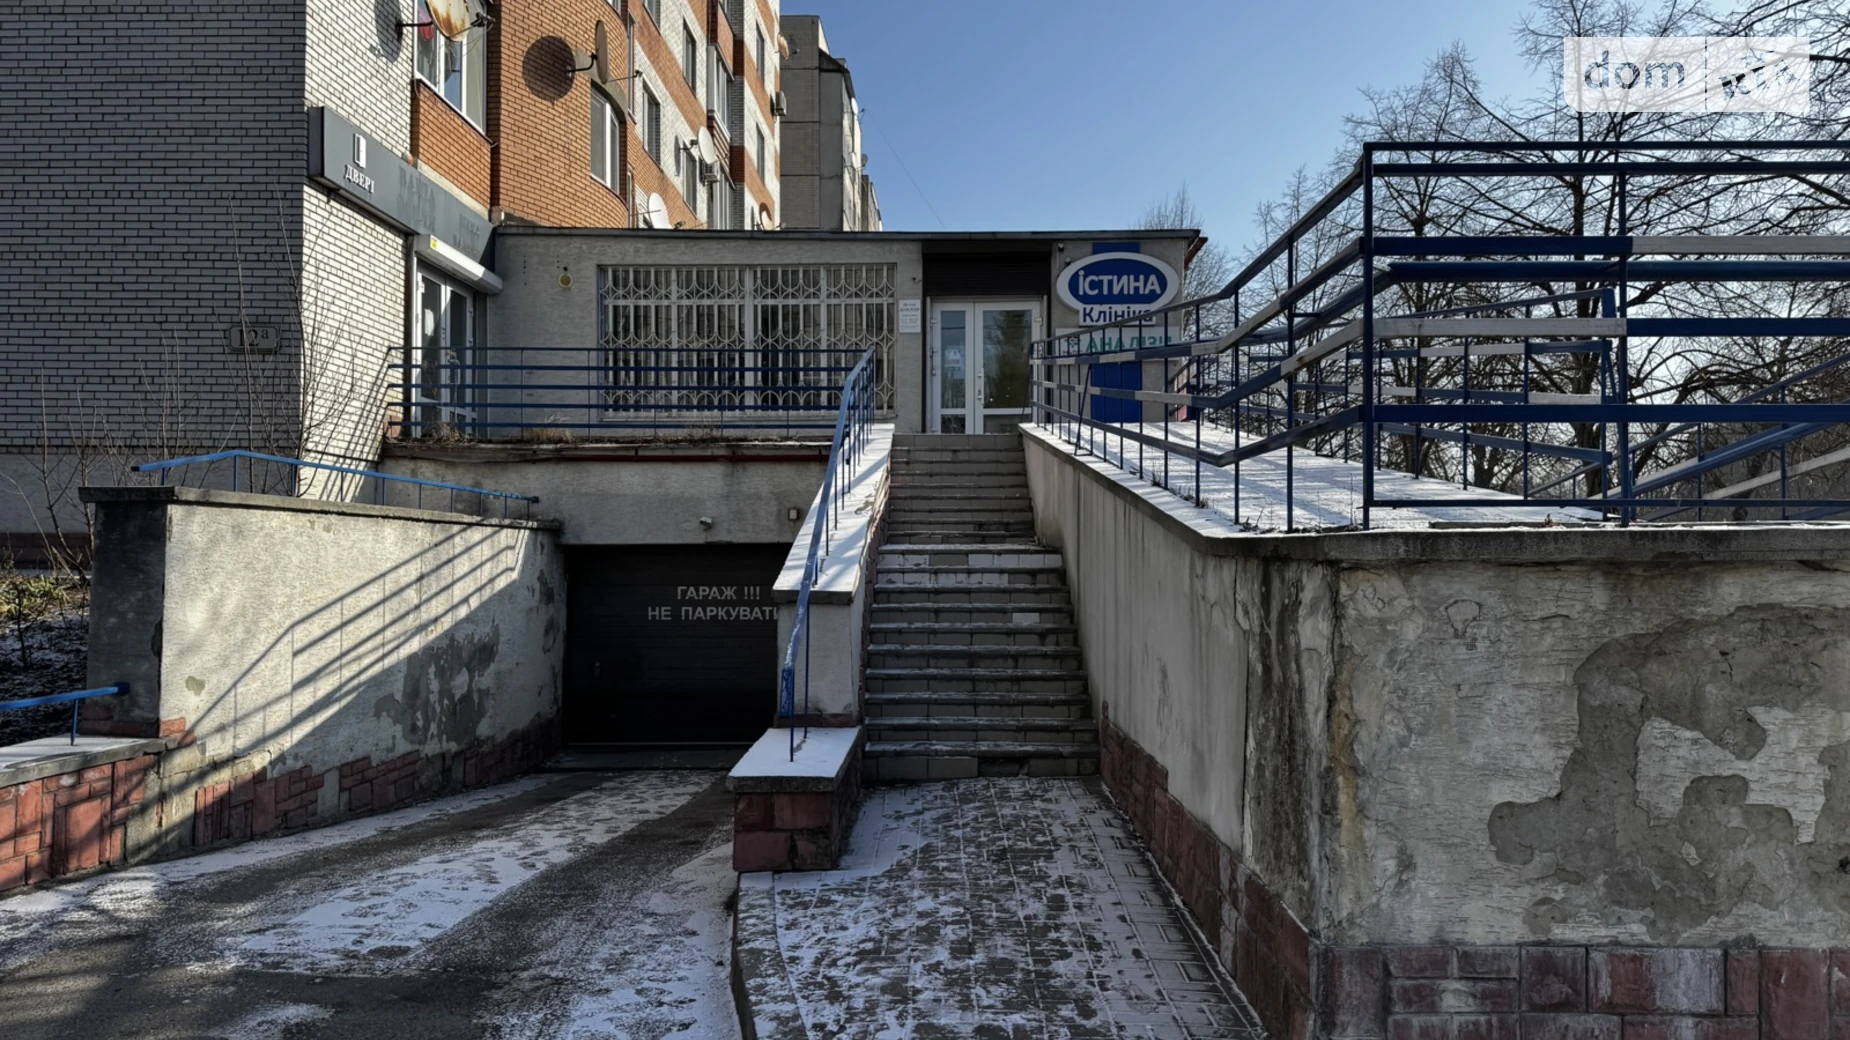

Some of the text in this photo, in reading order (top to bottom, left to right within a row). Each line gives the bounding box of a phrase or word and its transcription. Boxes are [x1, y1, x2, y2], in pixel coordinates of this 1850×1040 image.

[345, 164, 375, 193] ДВЕРІ
[677, 585, 760, 600] ГАРАЖ !!!
[648, 606, 672, 620] НЕ
